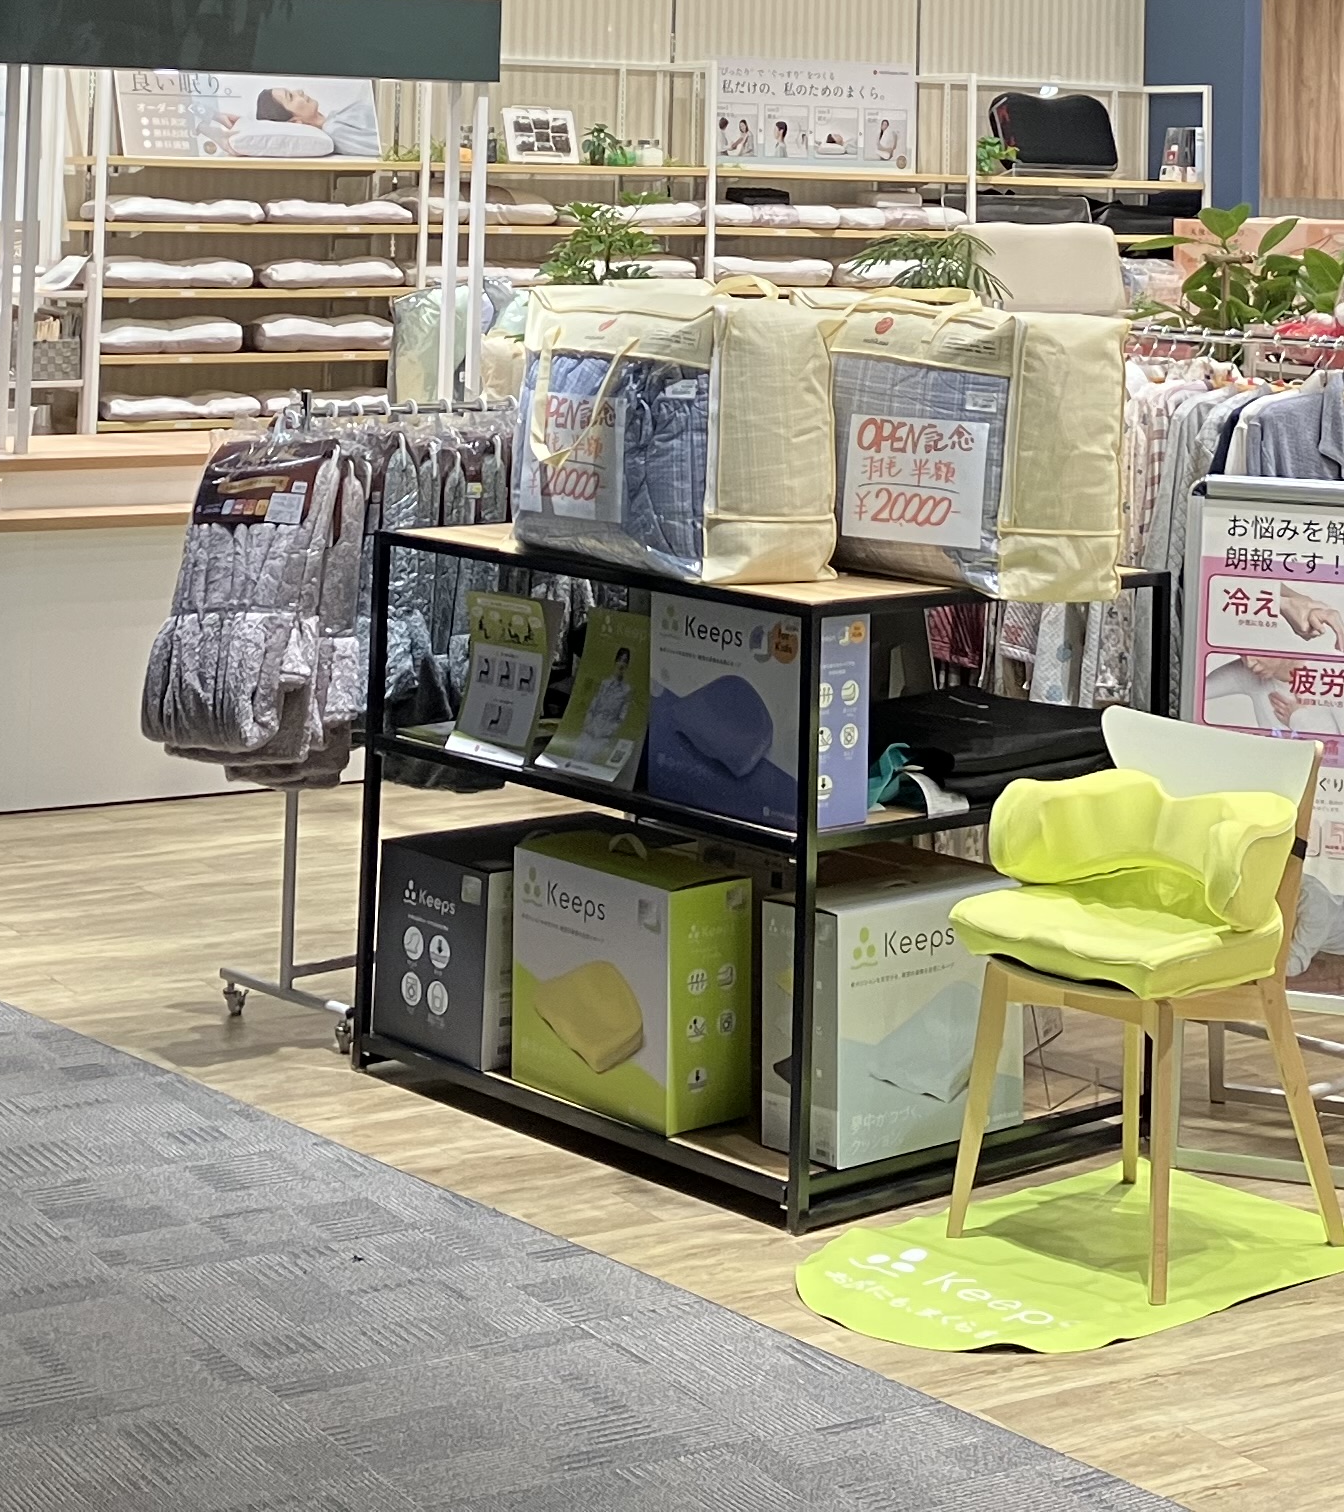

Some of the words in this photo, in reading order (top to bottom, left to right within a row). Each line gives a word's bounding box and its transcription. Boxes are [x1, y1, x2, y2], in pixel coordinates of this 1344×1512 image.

[131, 71, 233, 96] 良い眠り。
[857, 417, 975, 454] OPEN記念
[861, 456, 903, 481] 羽毛
[911, 458, 956, 487] 半額
[1224, 545, 1340, 575] 朗報です！
[1221, 587, 1279, 619] 冷え
[684, 615, 743, 650] Keeps
[418, 888, 456, 916] Keeps
[547, 880, 606, 923] Keeps
[884, 927, 955, 957] Keeps
